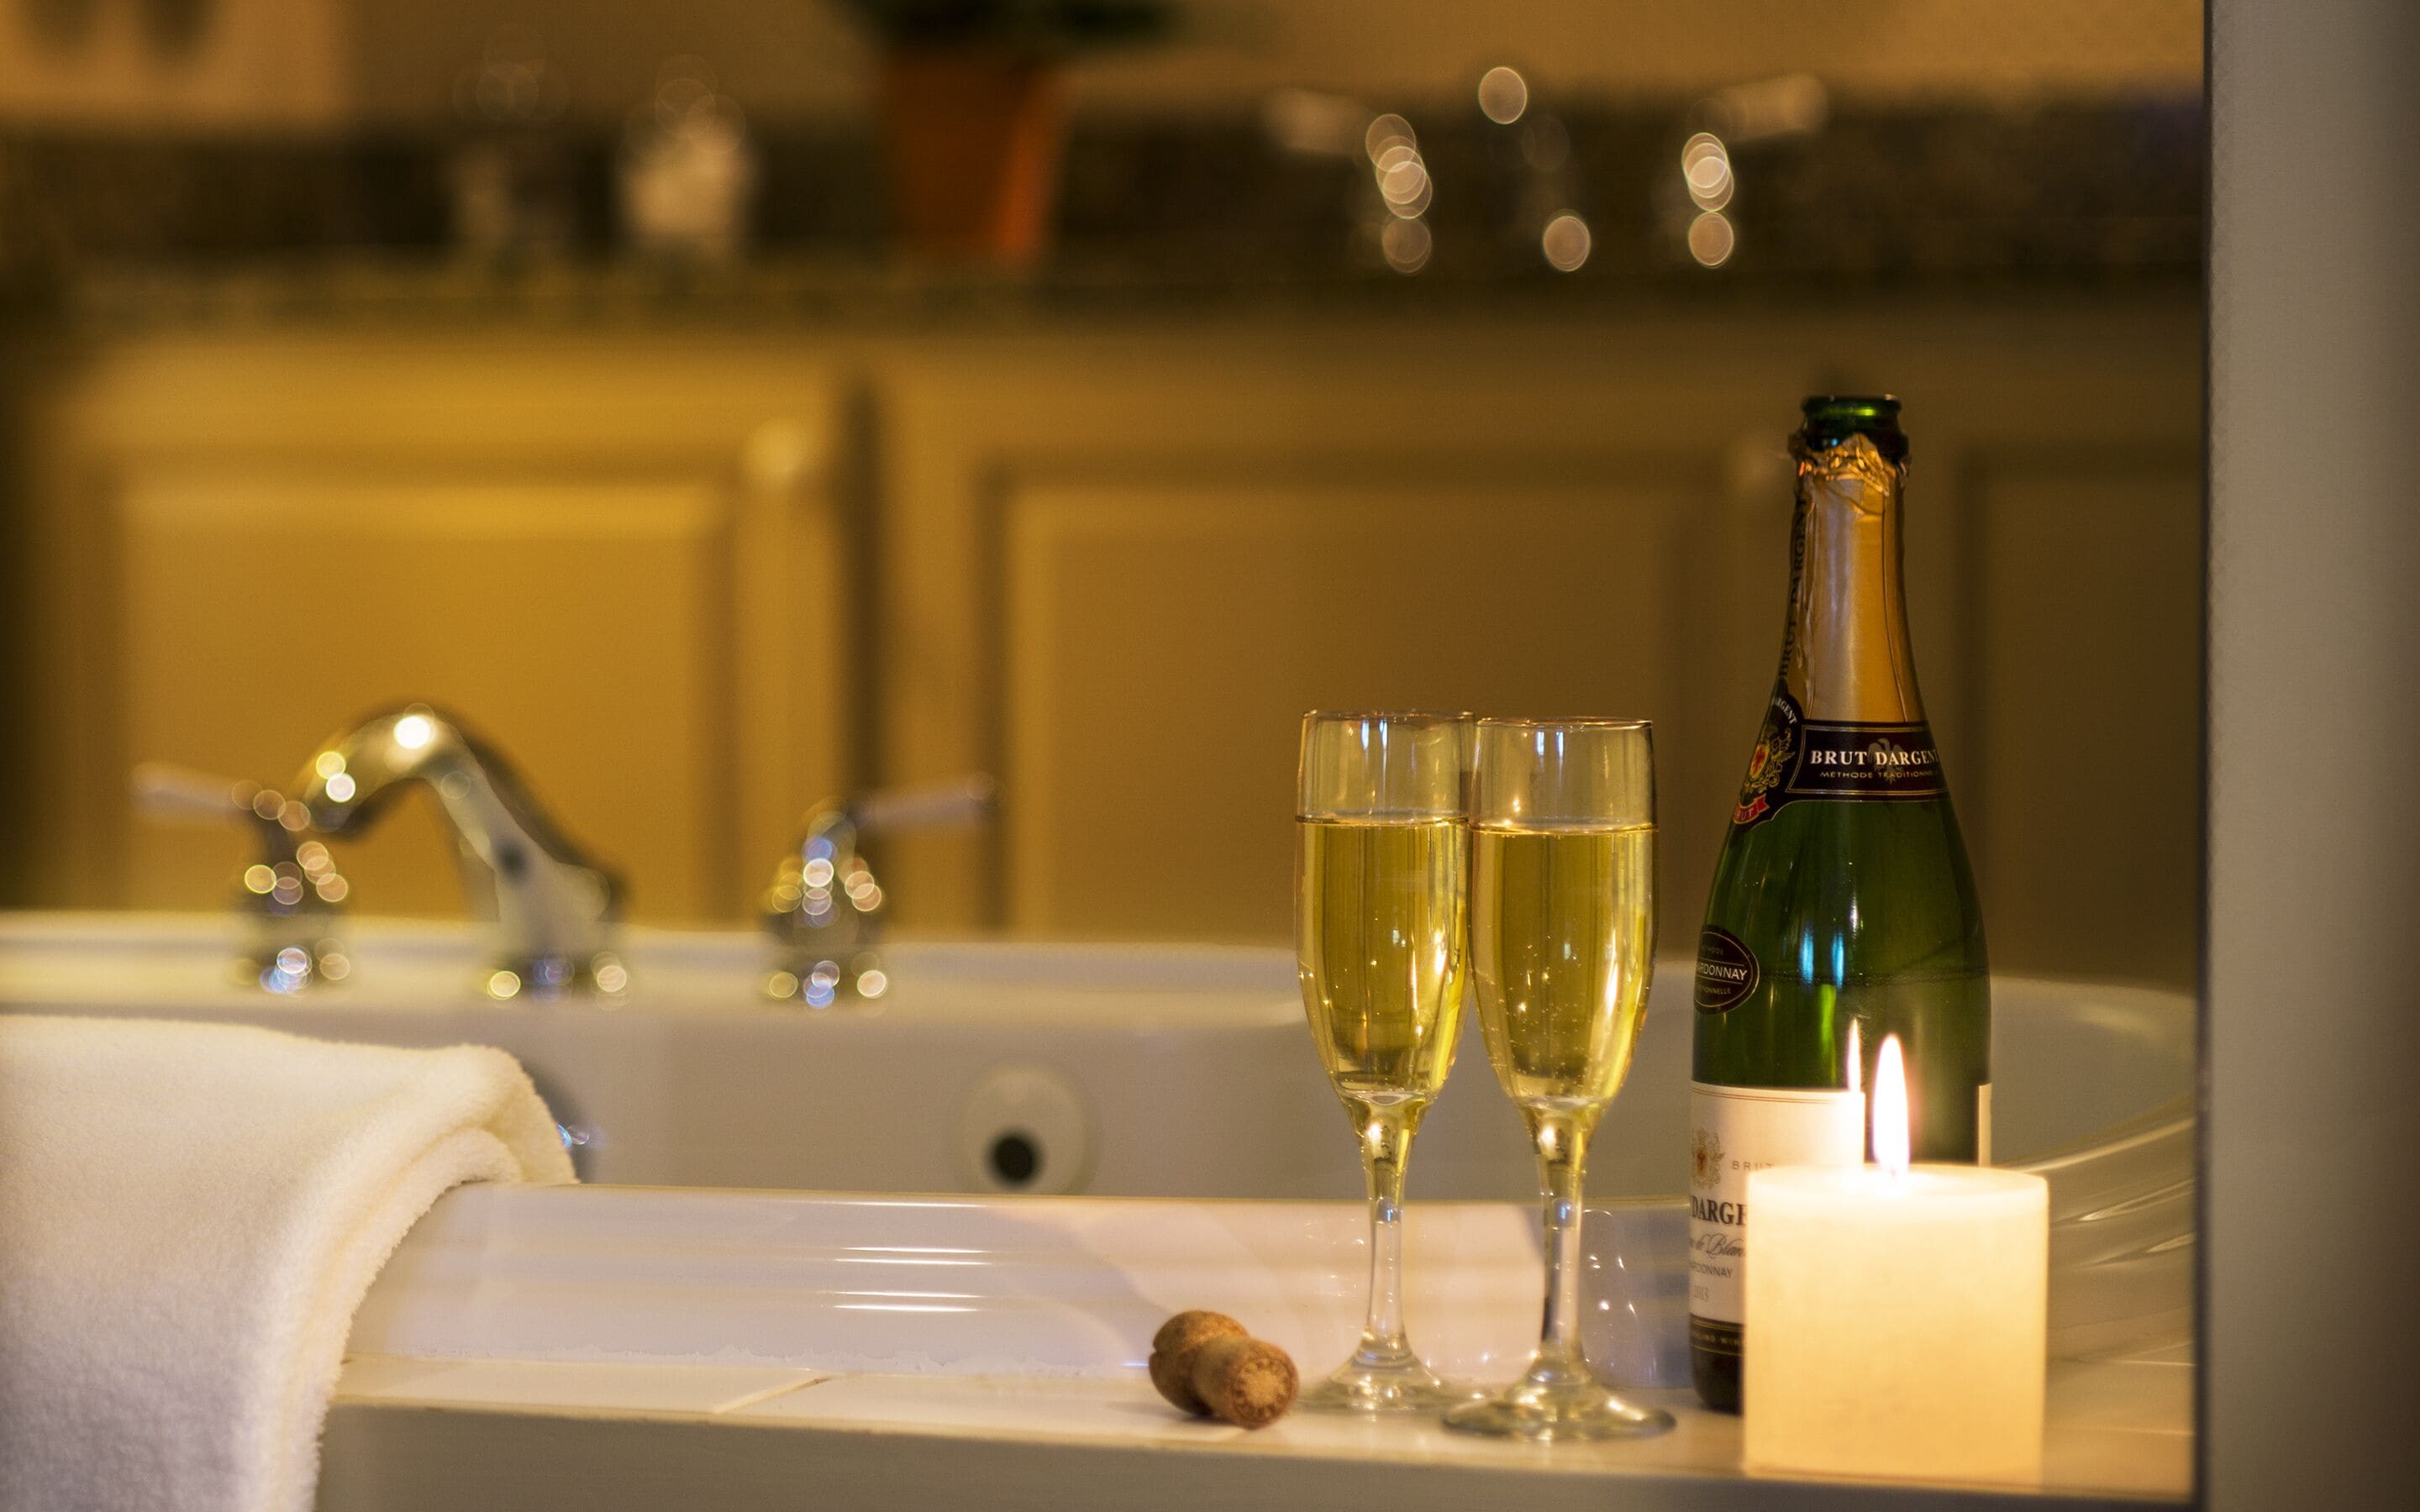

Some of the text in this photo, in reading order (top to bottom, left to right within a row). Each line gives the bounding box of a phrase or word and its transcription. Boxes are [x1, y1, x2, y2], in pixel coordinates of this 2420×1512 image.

[1810, 748, 1939, 766] BRUT DARGEN
[1691, 1195, 1747, 1226] DARGE
